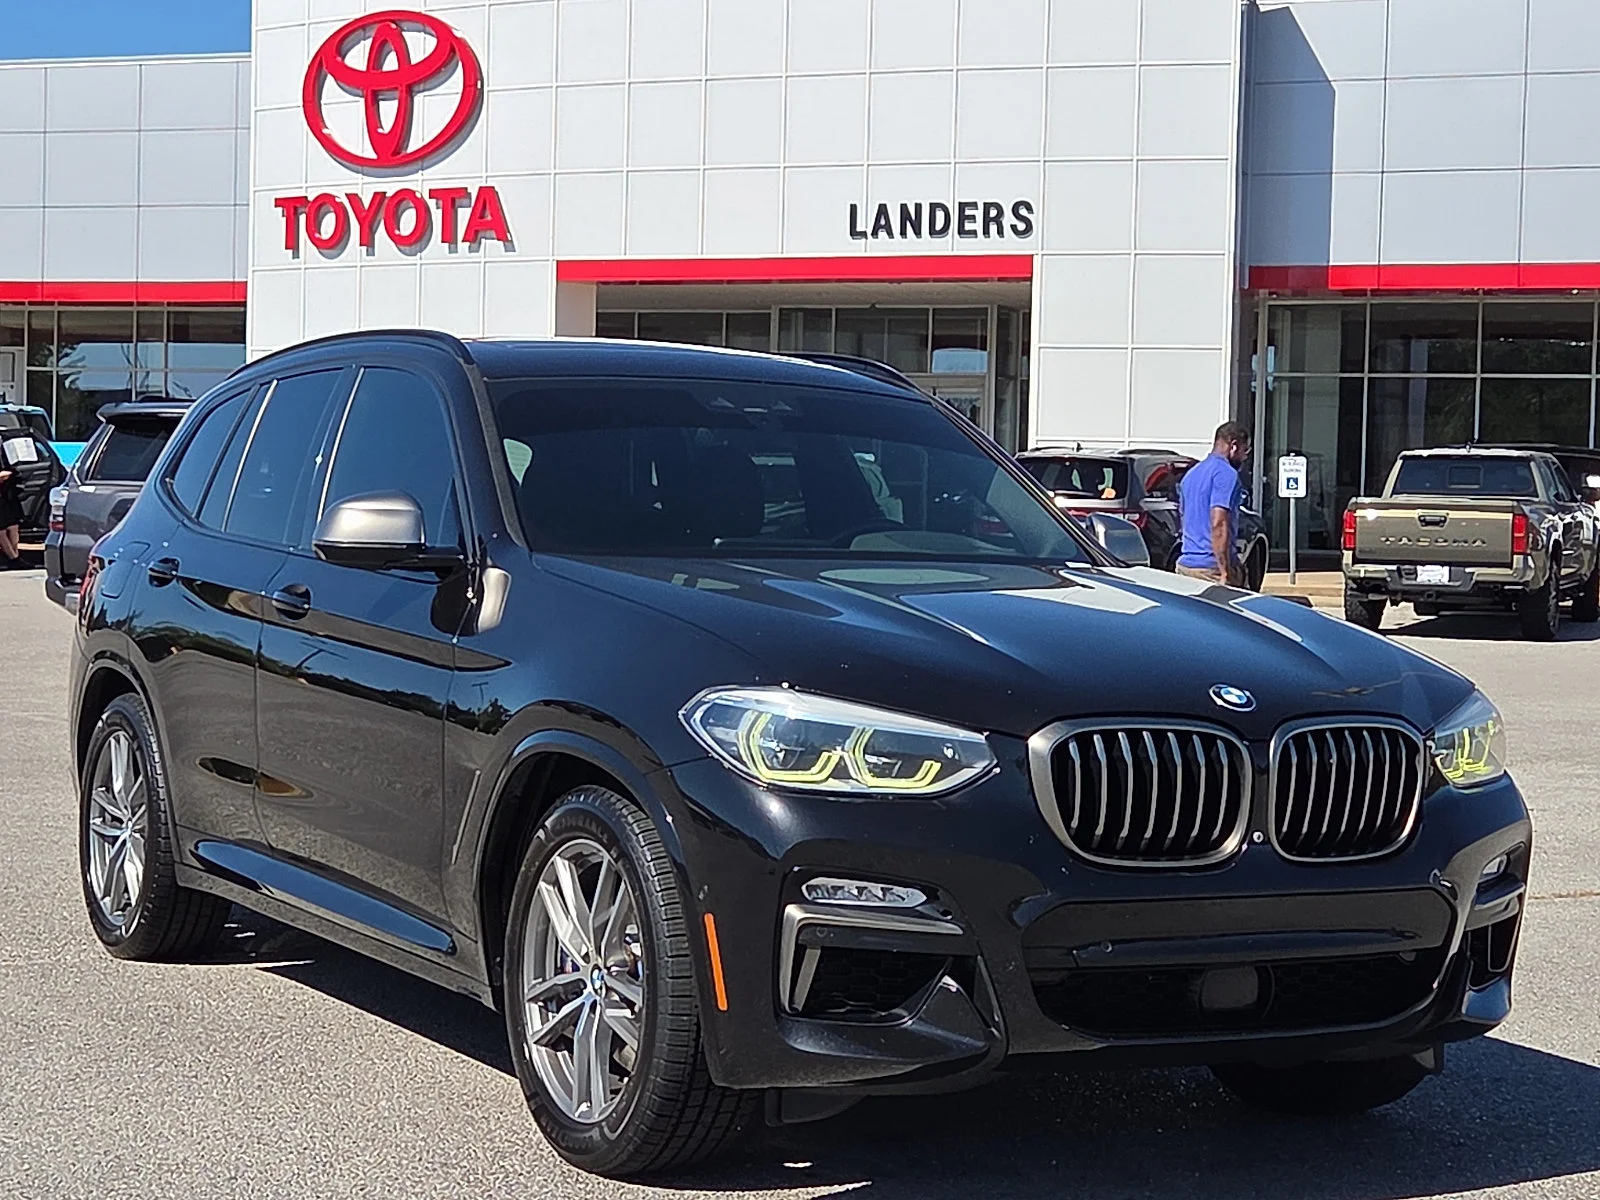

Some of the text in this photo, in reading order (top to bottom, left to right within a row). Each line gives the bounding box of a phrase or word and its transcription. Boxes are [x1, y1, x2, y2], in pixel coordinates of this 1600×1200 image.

[275, 186, 509, 250] TOYOTA
[849, 201, 1034, 239] LANDERS
[1380, 536, 1487, 548] TACOMA
